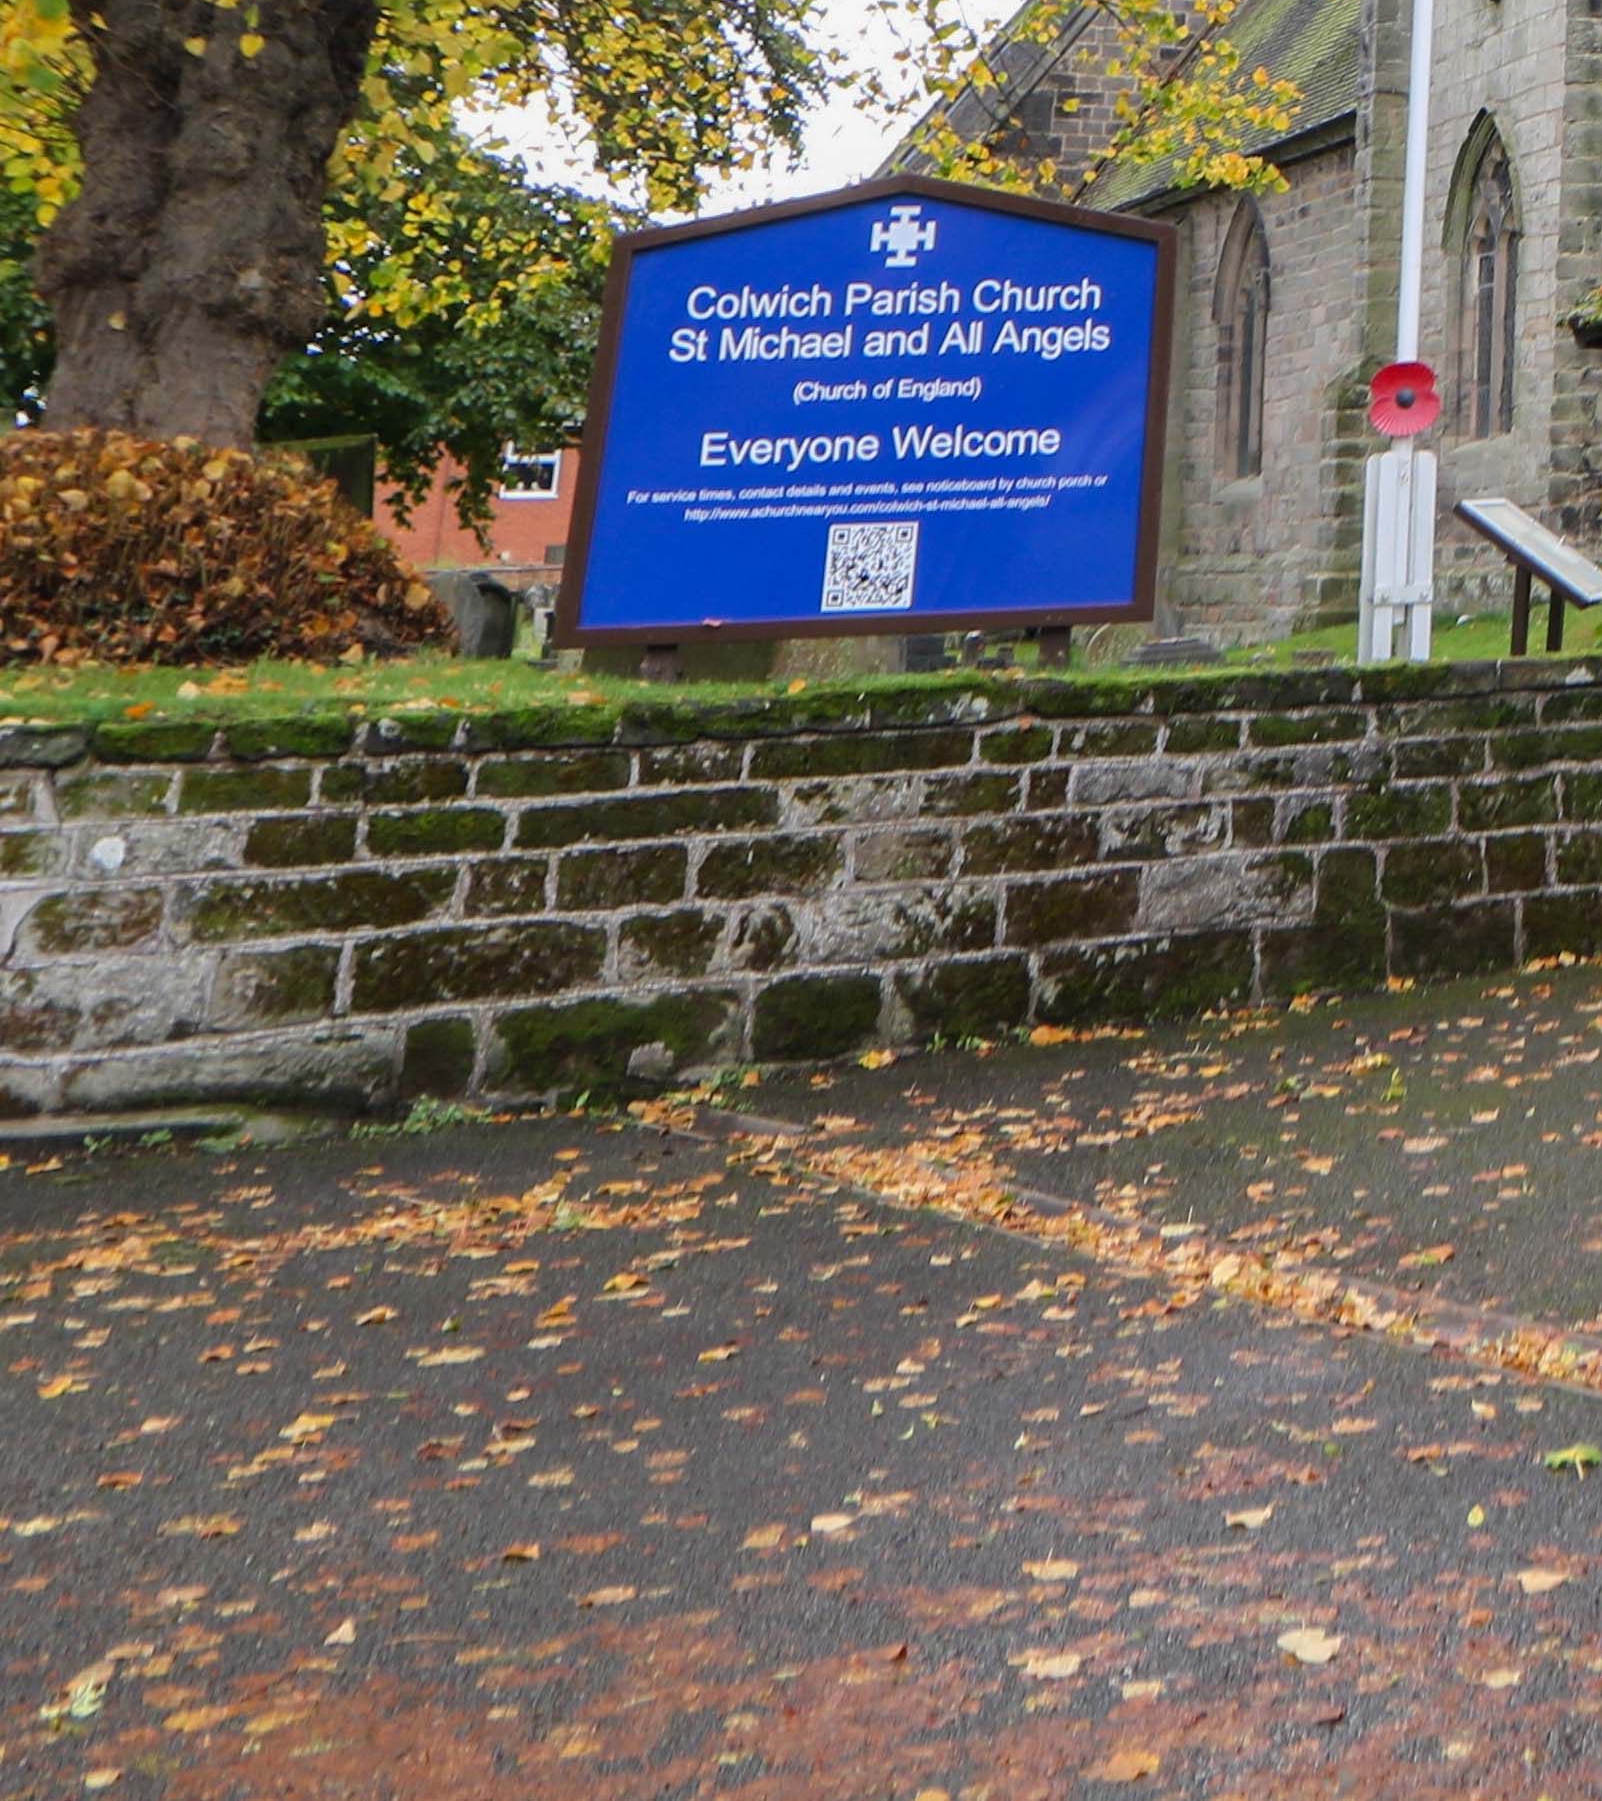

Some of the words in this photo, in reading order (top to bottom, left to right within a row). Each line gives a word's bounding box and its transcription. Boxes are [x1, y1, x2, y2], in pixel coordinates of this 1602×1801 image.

[686, 283, 833, 320] Colwich
[844, 280, 961, 316] Parish
[972, 277, 1101, 314] Church
[669, 327, 709, 362] St
[718, 323, 853, 361] Michael
[863, 320, 931, 357] and
[938, 319, 984, 355] All
[991, 317, 1111, 361] Angels
[793, 379, 868, 406] (Church
[872, 378, 895, 400] of
[897, 375, 983, 403] England)
[700, 430, 880, 472] Everyone
[892, 423, 1061, 460] Welcome
[626, 489, 649, 504] For
[651, 489, 697, 503] service
[699, 487, 736, 502] times,
[738, 484, 784, 499] contact
[786, 483, 826, 498] details
[828, 482, 853, 496] and
[854, 481, 898, 496] events,
[901, 480, 923, 494] see
[926, 476, 997, 493] noticeboard
[998, 476, 1016, 493] by
[1015, 474, 1057, 490] church
[1058, 474, 1093, 490] porch
[1093, 474, 1108, 487] or
